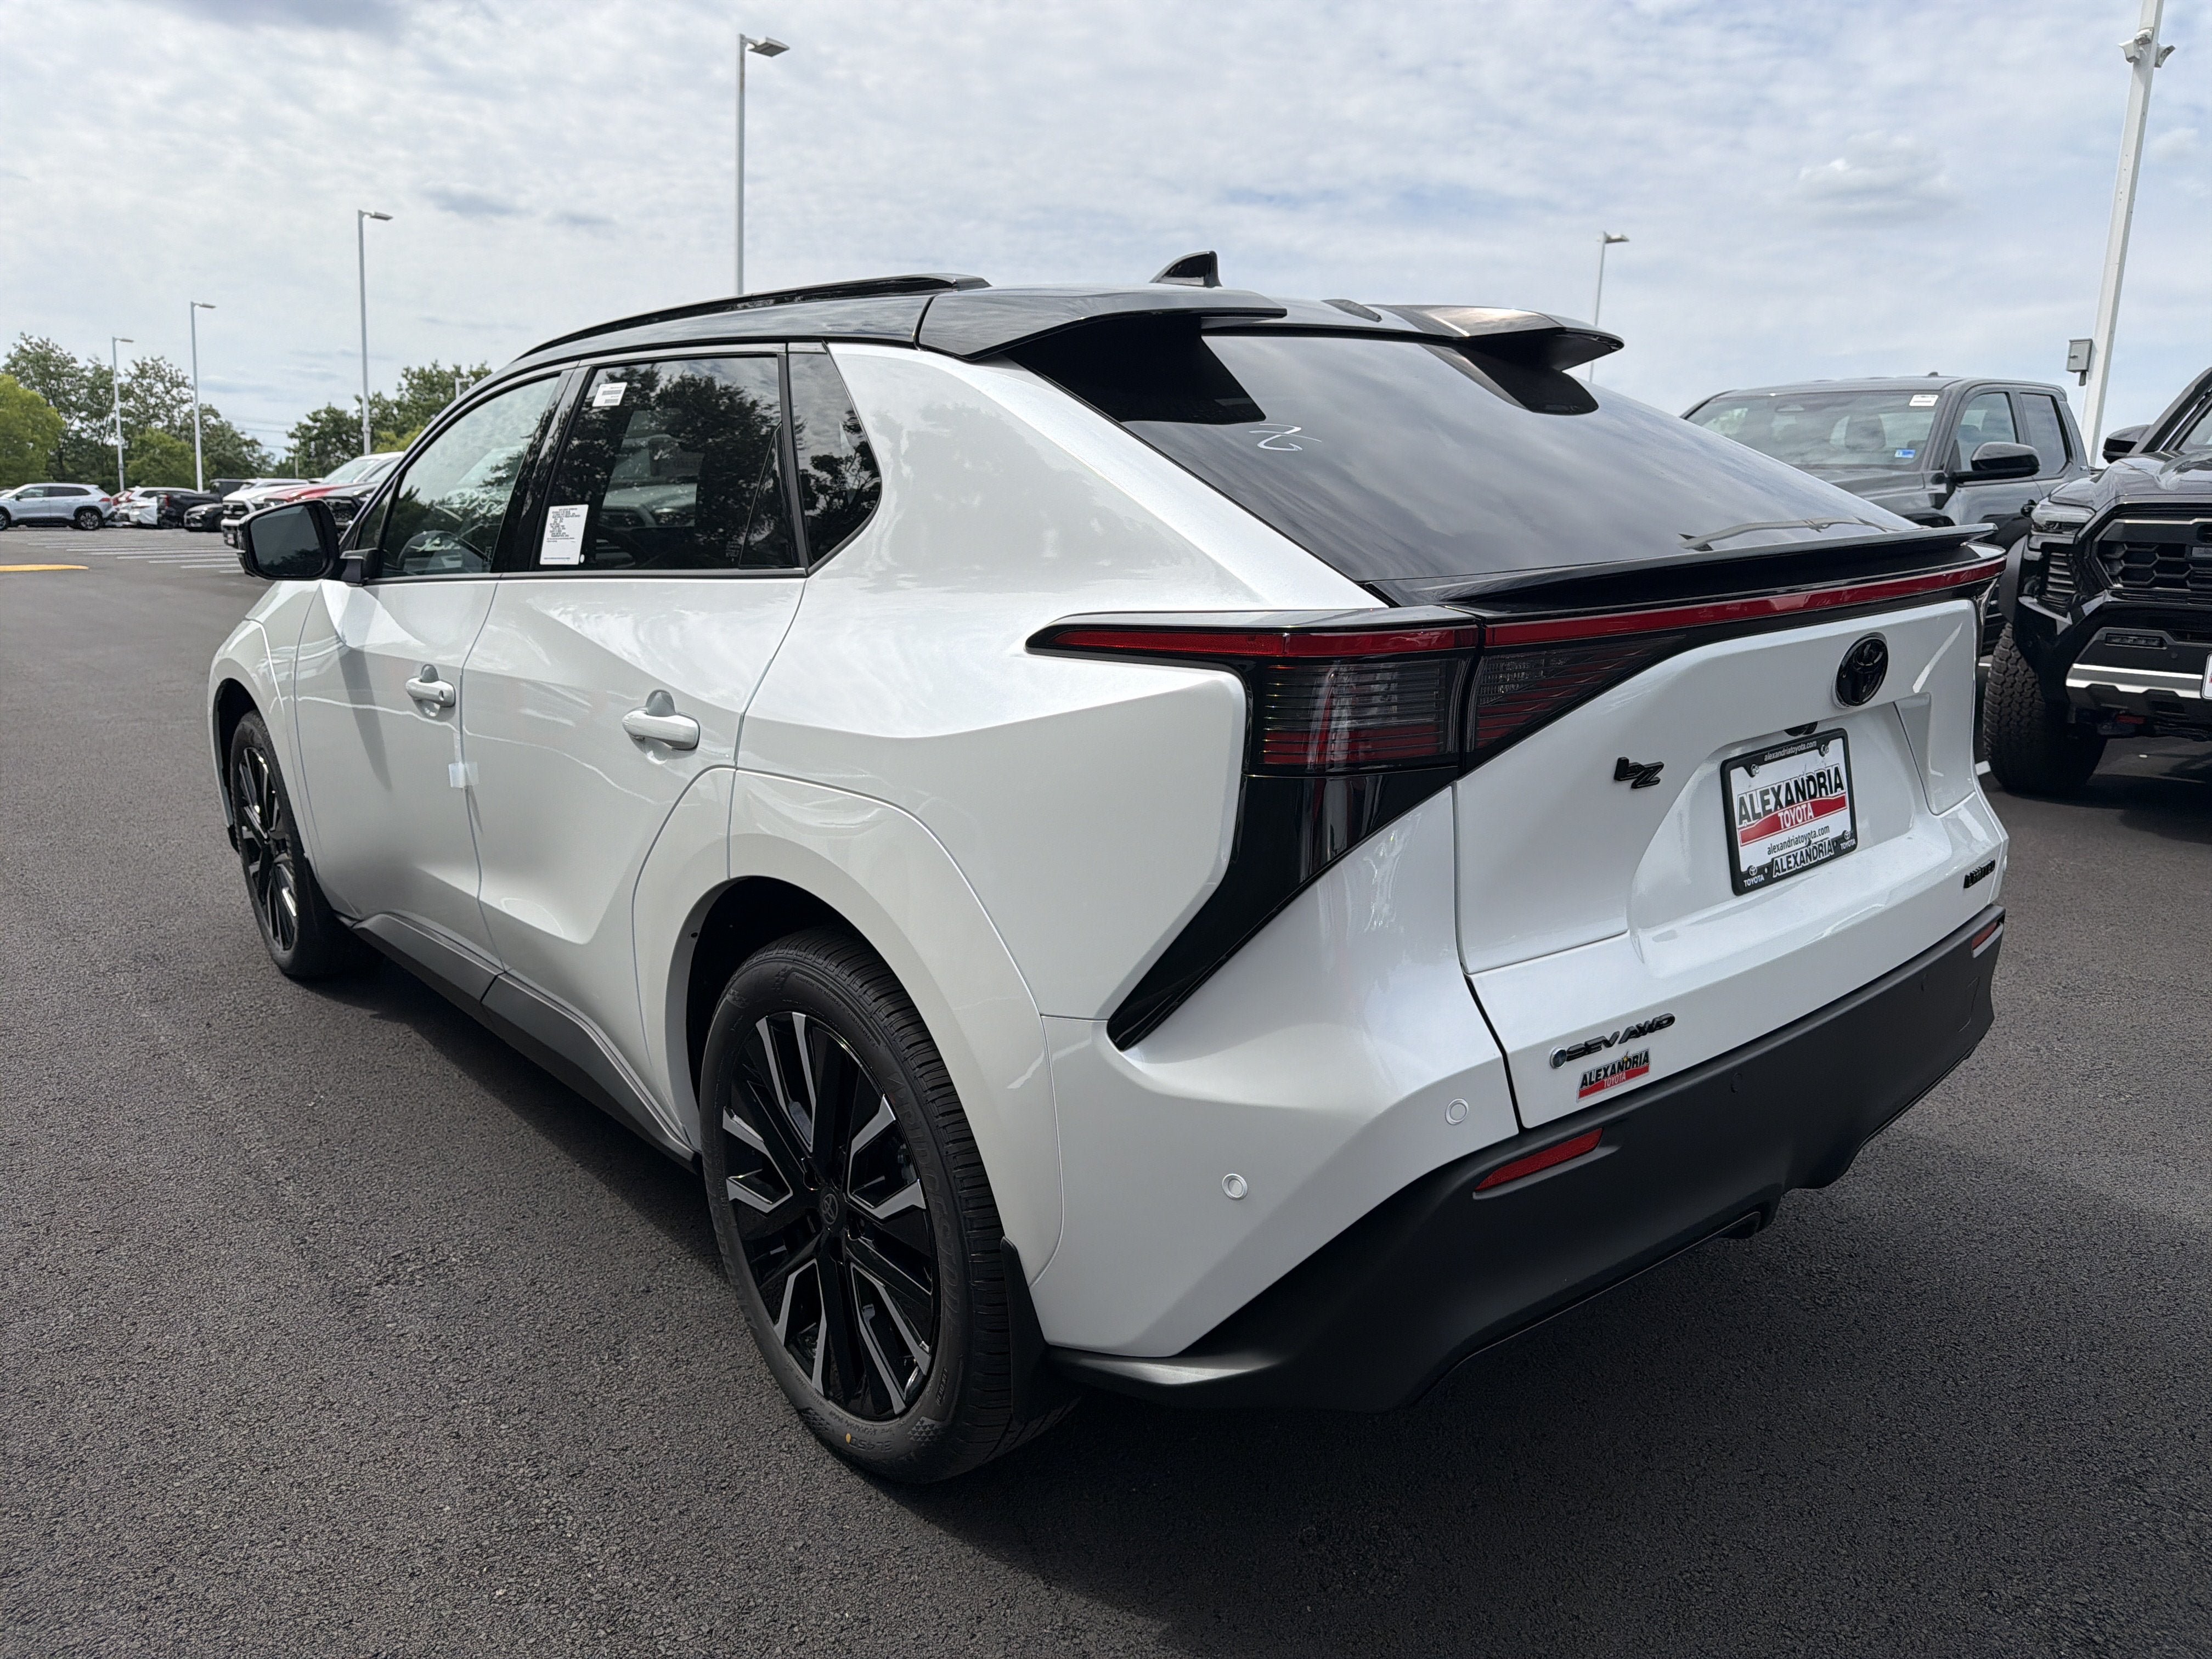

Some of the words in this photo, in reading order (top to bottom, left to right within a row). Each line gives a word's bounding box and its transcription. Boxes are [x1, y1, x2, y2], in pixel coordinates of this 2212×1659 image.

[1764, 741, 1817, 761] alexandriatoyota.com
[1738, 766, 1844, 826] ALEXANDRIA
[1778, 802, 1814, 830] TOYOTA
[1767, 825, 1830, 855] alexandriatoyota.com
[1840, 838, 1856, 850] TOYOTA
[1773, 838, 1835, 877] ALEXANDRIA
[1743, 874, 1765, 887] TOYOTA
[1618, 1013, 1675, 1044] AWD
[1579, 1048, 1650, 1090] ALEXANDRIA
[1604, 1071, 1626, 1088] TOYOTA
